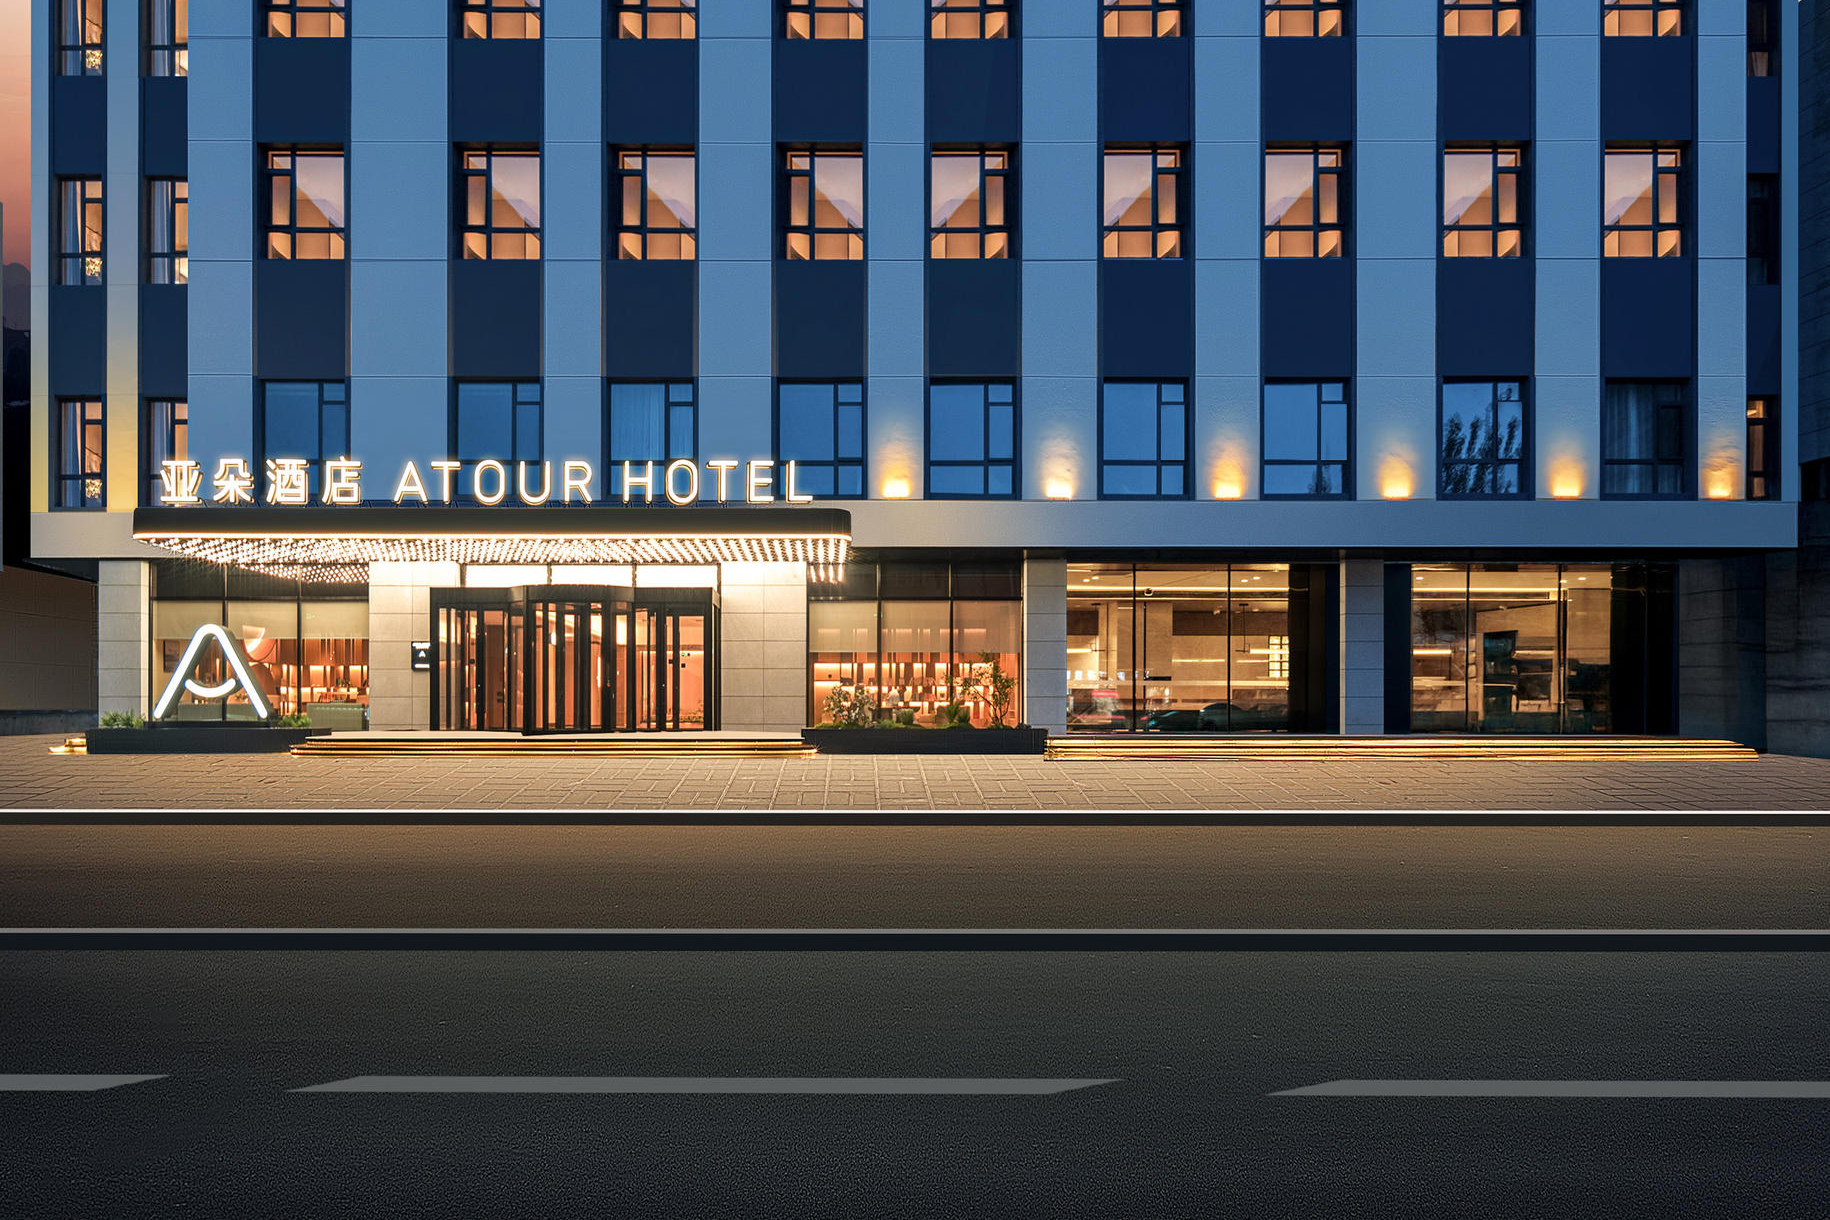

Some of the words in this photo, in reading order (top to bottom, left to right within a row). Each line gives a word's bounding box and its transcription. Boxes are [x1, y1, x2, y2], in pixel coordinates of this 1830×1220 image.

[160, 456, 362, 505] 亚朵酒店
[393, 459, 593, 505] ATOUR
[622, 458, 813, 505] HOTEL
